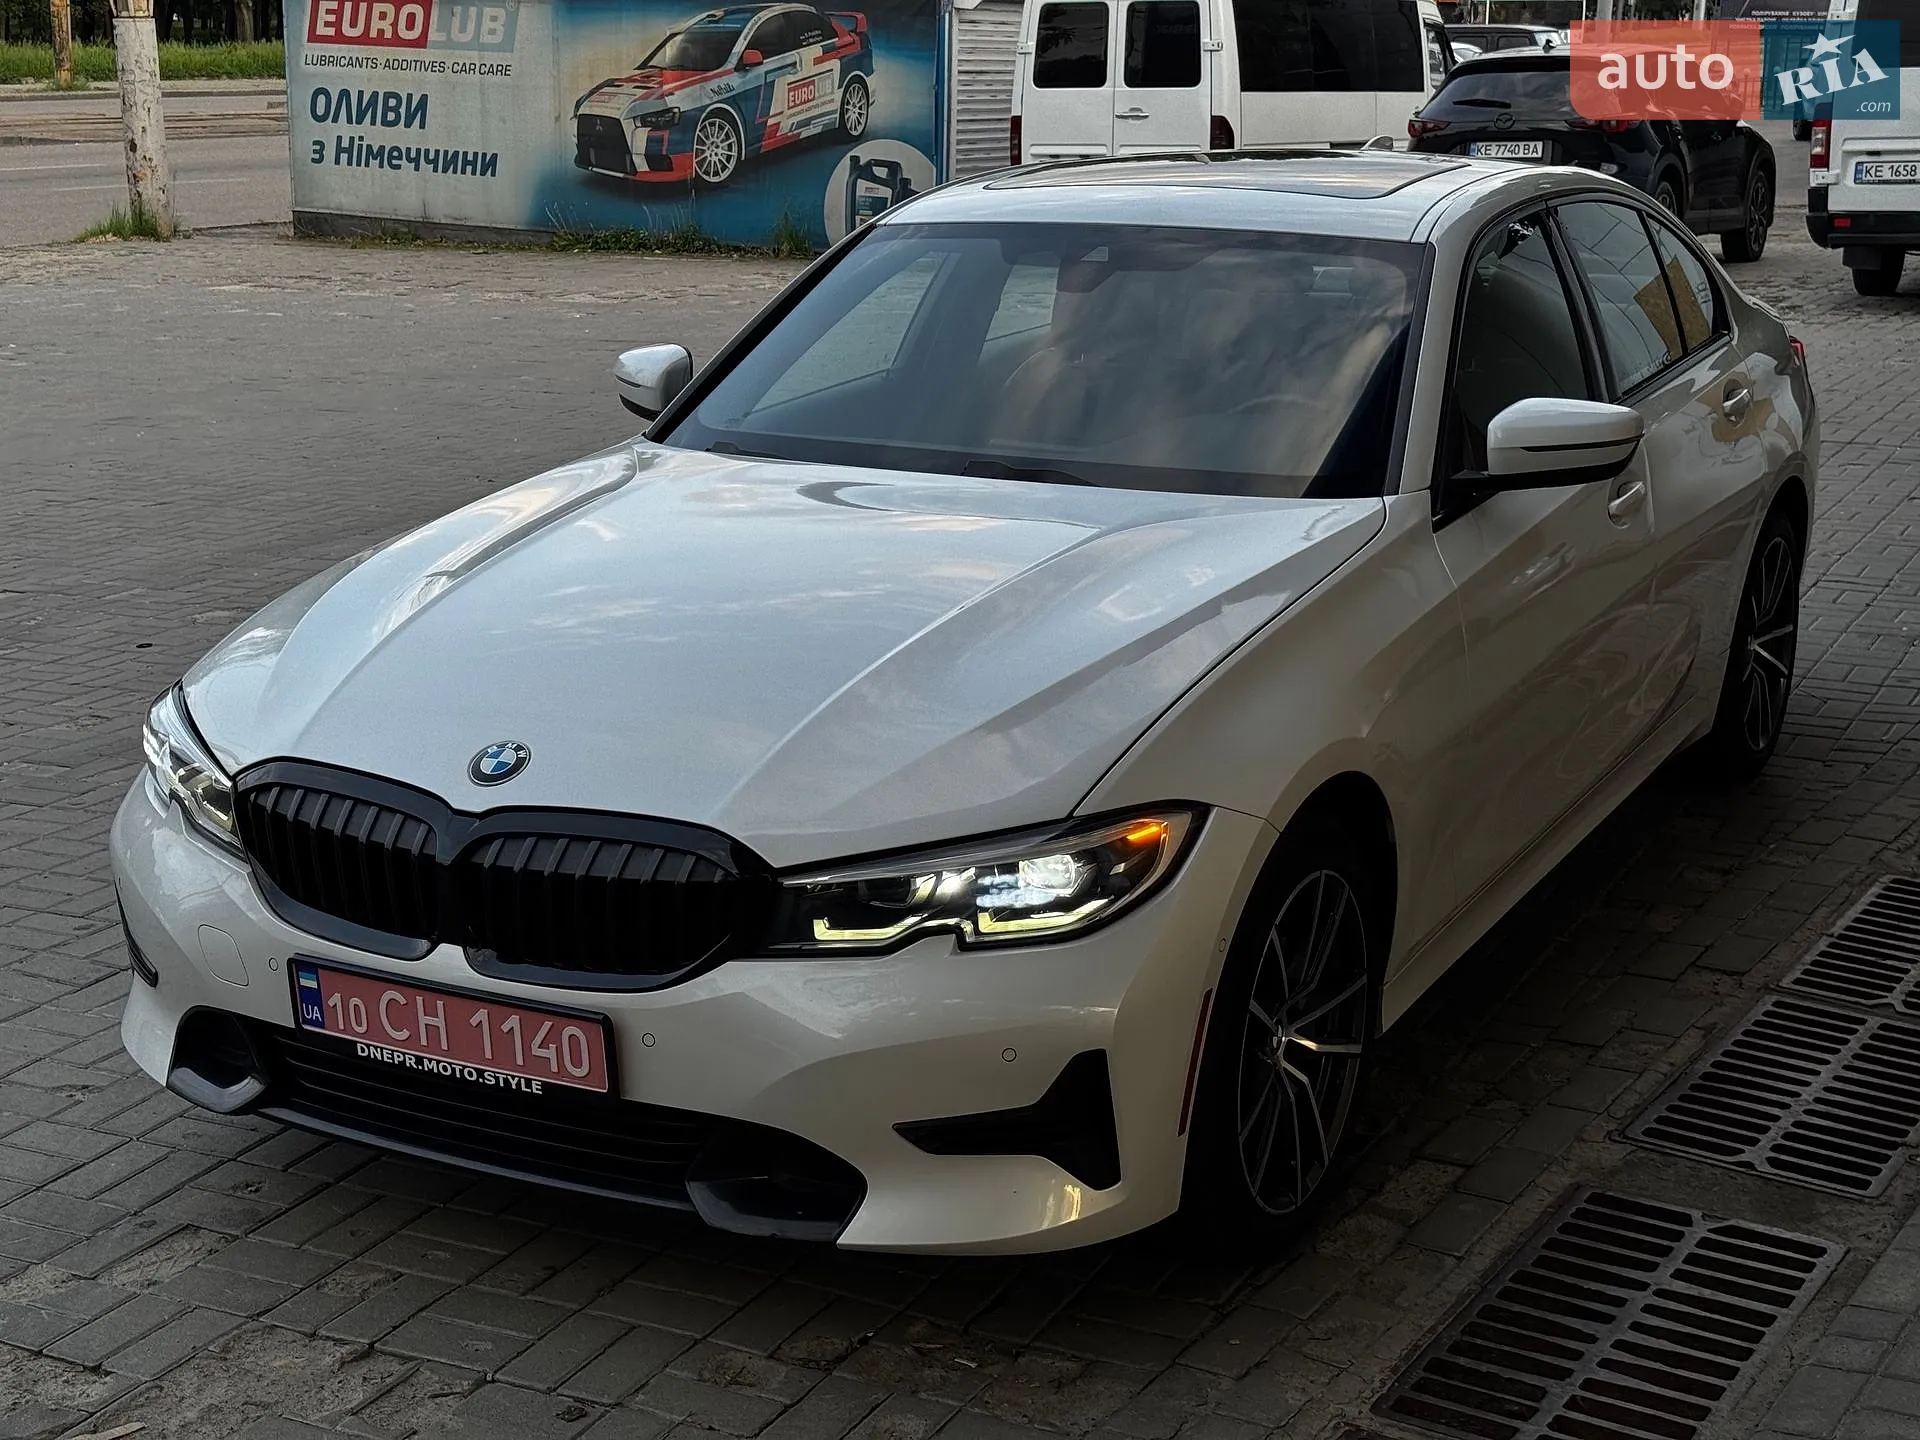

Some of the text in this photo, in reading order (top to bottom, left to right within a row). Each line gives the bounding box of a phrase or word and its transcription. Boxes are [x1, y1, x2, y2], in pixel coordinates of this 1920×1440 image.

[315, 0, 507, 44] EUROLUB
[478, 63, 512, 77] CARE
[309, 86, 429, 130] ОЛИВИ
[310, 135, 499, 177] з Німеччини
[1476, 143, 1539, 156] KE 7740 BA
[1864, 164, 1917, 178] KE 1658
[302, 990, 591, 1078] UA 10 CH 1140
[356, 1042, 543, 1095] DNEPR.MOTO.STYLE
